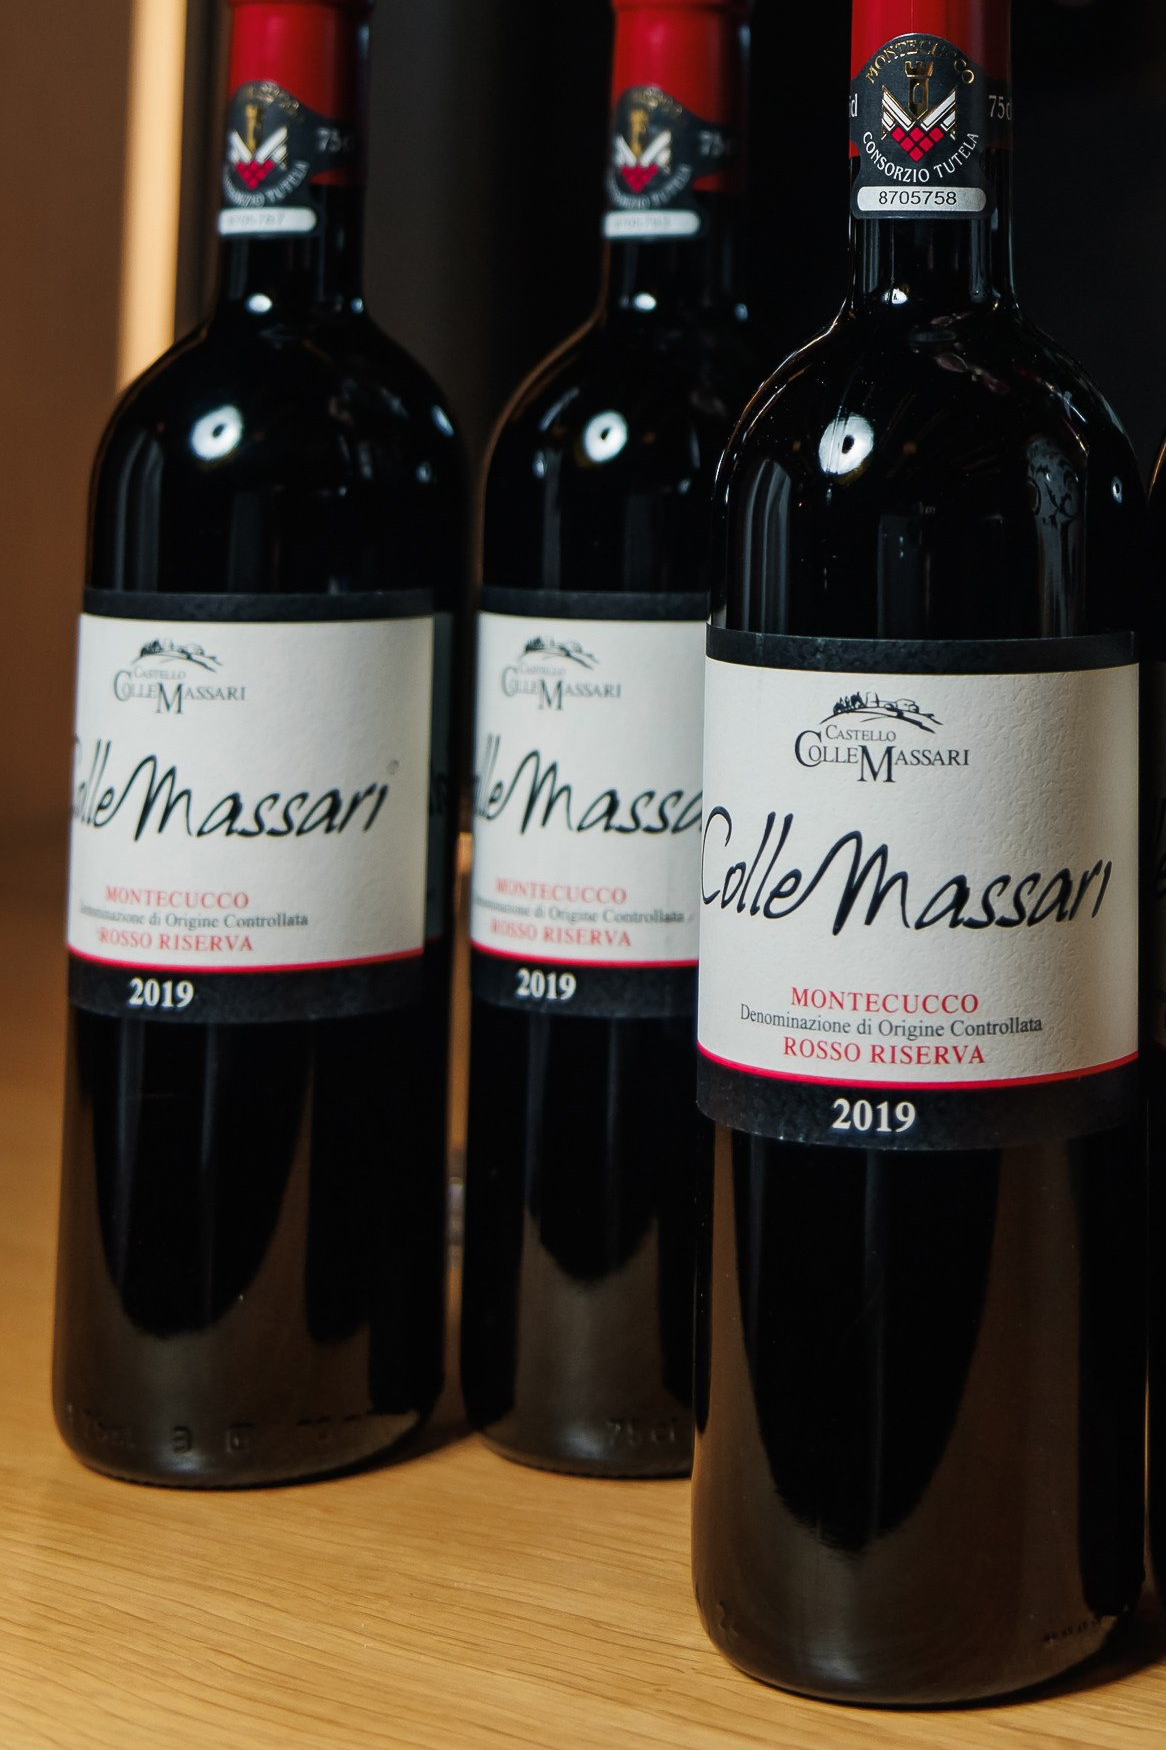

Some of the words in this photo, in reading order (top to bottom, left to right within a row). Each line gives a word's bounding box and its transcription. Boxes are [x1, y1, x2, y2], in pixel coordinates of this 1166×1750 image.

[866, 40, 975, 84] MONTECUCO
[863, 131, 930, 183] CONSORZIO
[933, 132, 979, 179] TUTELA
[878, 190, 958, 206] 8705758
[825, 724, 897, 742] CASTELLO
[74, 736, 398, 842] olleMassari
[105, 885, 250, 910] MONTECUCCO
[165, 913, 219, 931] Origine
[223, 912, 309, 929] Controllata
[543, 924, 632, 947] RISERVA
[98, 928, 152, 949] ROSSO
[158, 933, 254, 952] RISERVA
[128, 977, 195, 1008] 2019
[516, 967, 577, 1000] 2019
[790, 986, 979, 1014] MONTECUCCO
[740, 1003, 851, 1034] Denominazione
[856, 1018, 872, 1035] di
[878, 1019, 945, 1041] Origine
[950, 1017, 1042, 1037] Controllata
[783, 1036, 861, 1063] ROSSO
[870, 1044, 985, 1065] RISERVA
[832, 1098, 916, 1133] 2019
